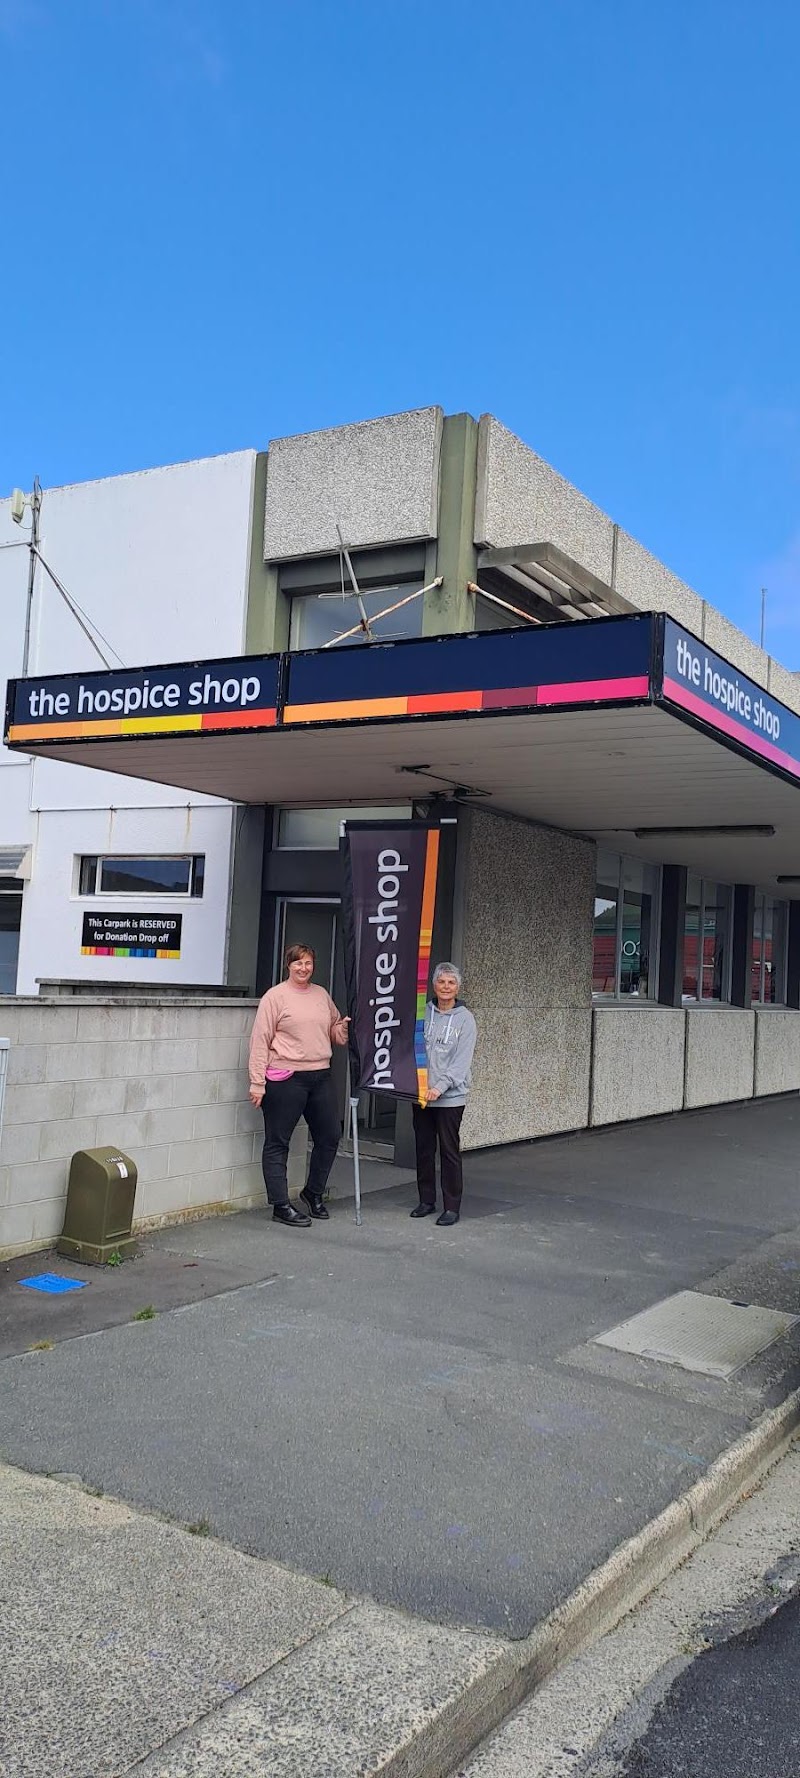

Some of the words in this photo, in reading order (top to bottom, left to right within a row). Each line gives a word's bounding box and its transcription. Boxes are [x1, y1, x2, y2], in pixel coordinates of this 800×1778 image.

[28, 689, 70, 717] the
[77, 679, 181, 714] hospice
[188, 674, 261, 706] shop
[676, 639, 701, 686] the
[704, 658, 751, 720] hospice
[753, 698, 780, 740] shop
[88, 918, 102, 927] This
[103, 918, 131, 929] Carpark
[132, 919, 138, 928] is
[139, 920, 176, 929] RESERVED
[368, 848, 409, 942] shop
[94, 931, 104, 941] for
[105, 932, 137, 942] Donation
[139, 933, 157, 944] Drop
[158, 933, 169, 942] off
[369, 953, 401, 1089] hospice
